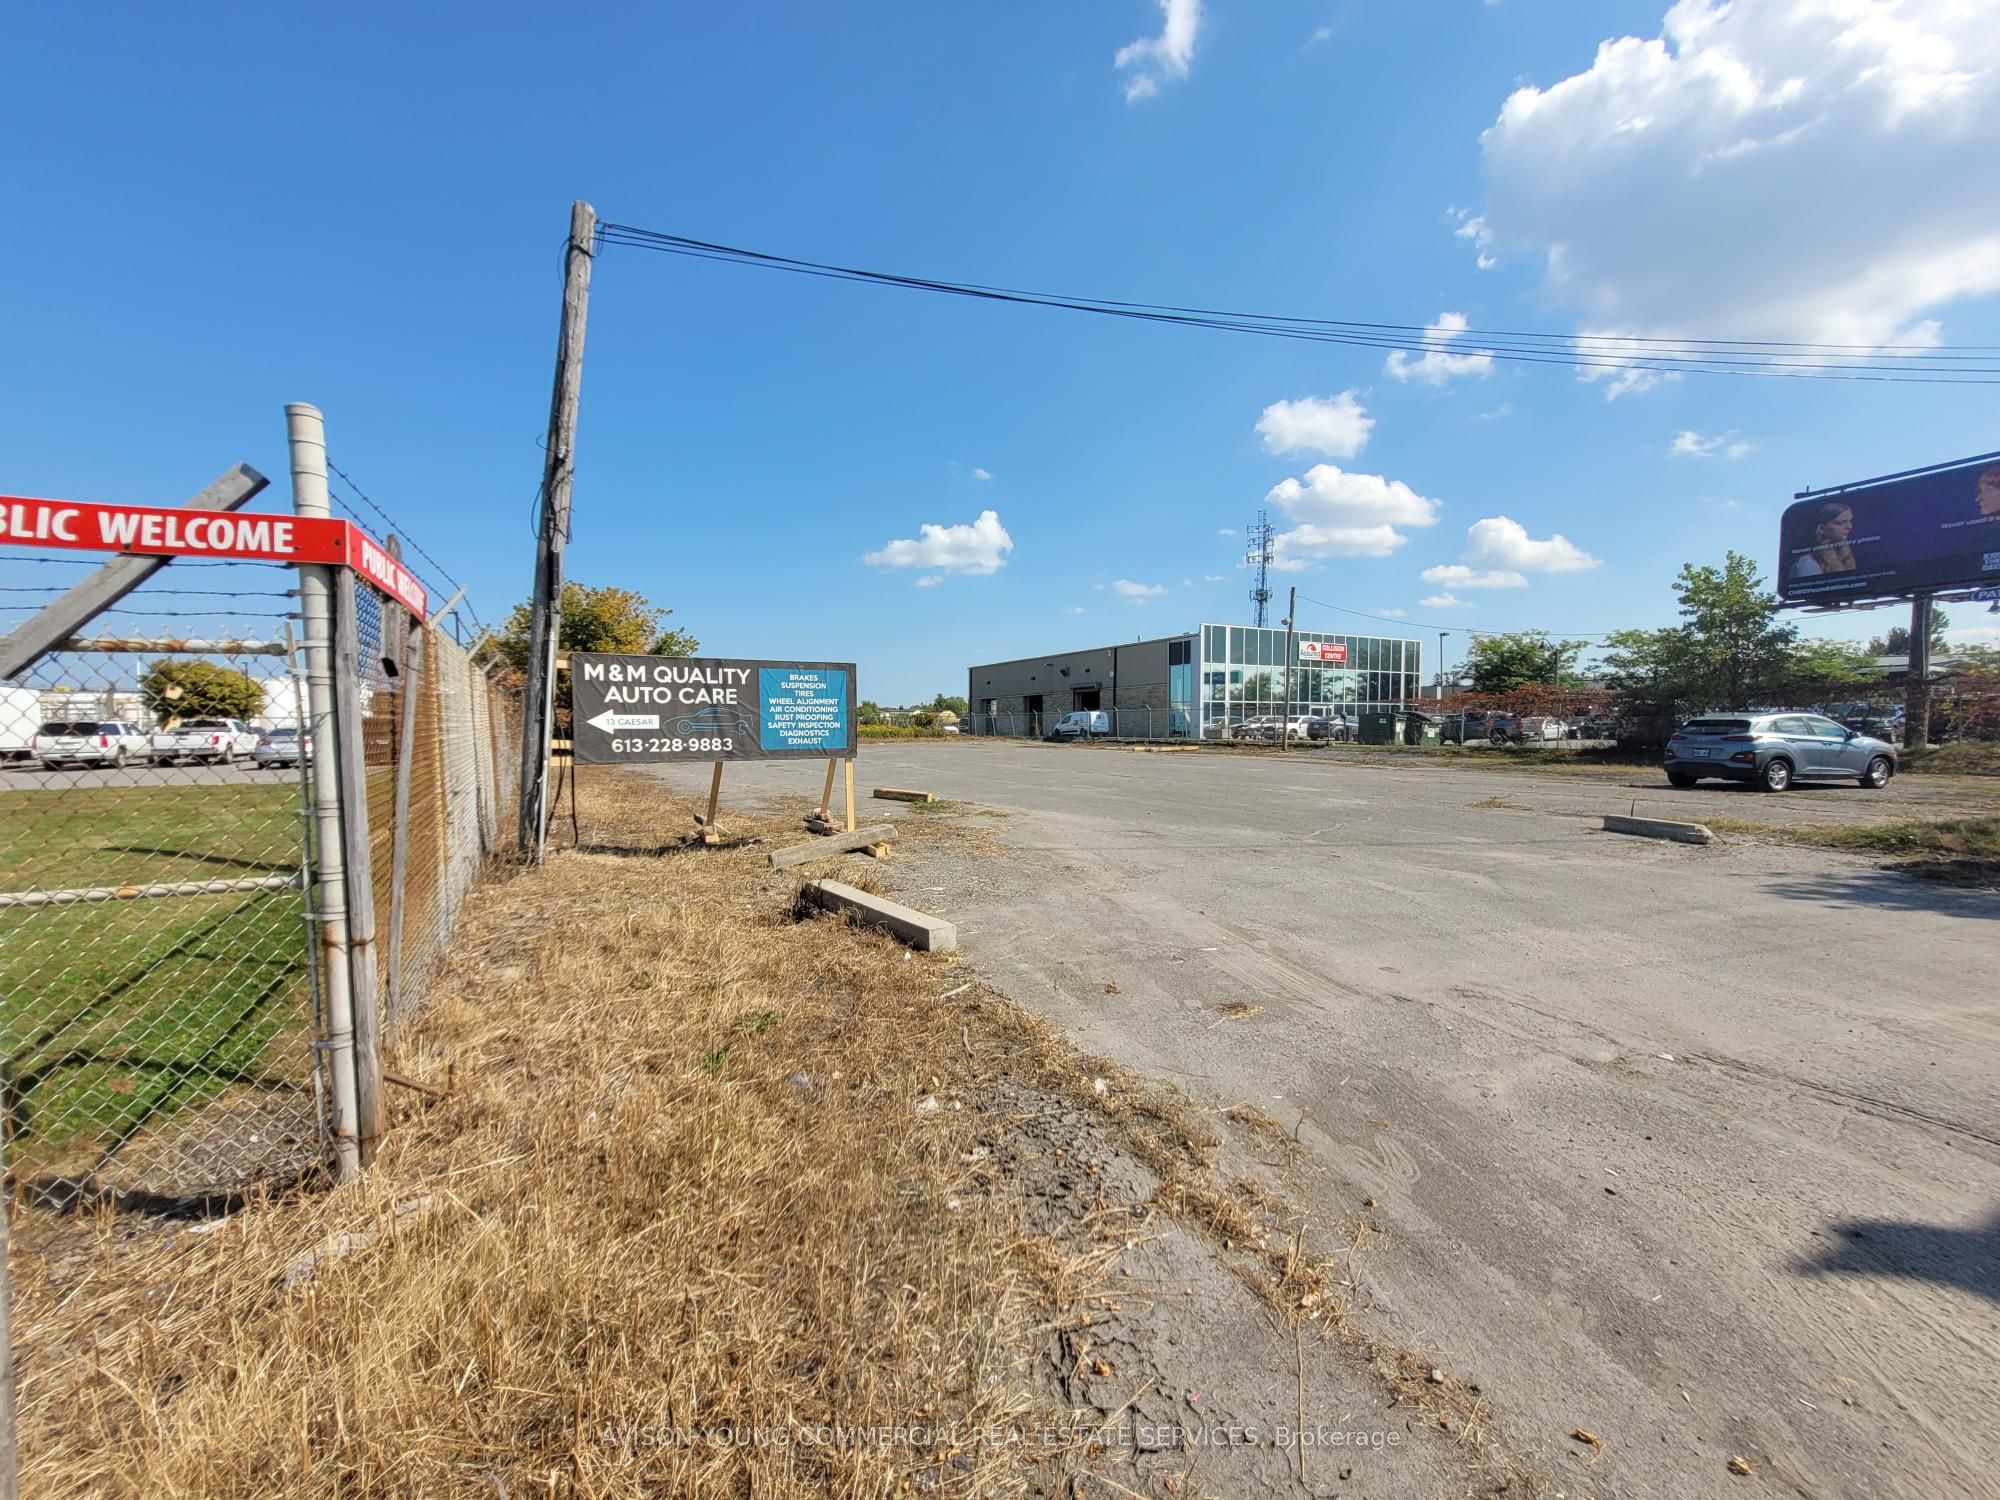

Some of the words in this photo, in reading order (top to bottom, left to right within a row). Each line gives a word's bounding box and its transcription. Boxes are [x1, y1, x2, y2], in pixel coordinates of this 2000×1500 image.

[97, 511, 295, 553] WELCOME
[362, 539, 396, 591] PUBLIC
[396, 568, 426, 616] WELCOME
[1300, 649, 1321, 657] Assured
[653, 665, 751, 685] QUALITY
[789, 673, 819, 682] BRAKES
[781, 681, 827, 689] SUSPENSION
[604, 685, 672, 704] AUTO
[678, 687, 738, 705] CARE
[769, 697, 795, 705] WHEEL
[605, 718, 616, 726] 13
[617, 718, 654, 726] CAESAR
[779, 729, 830, 737] DIAGNOSTICS
[788, 737, 822, 745] EXHAUST
